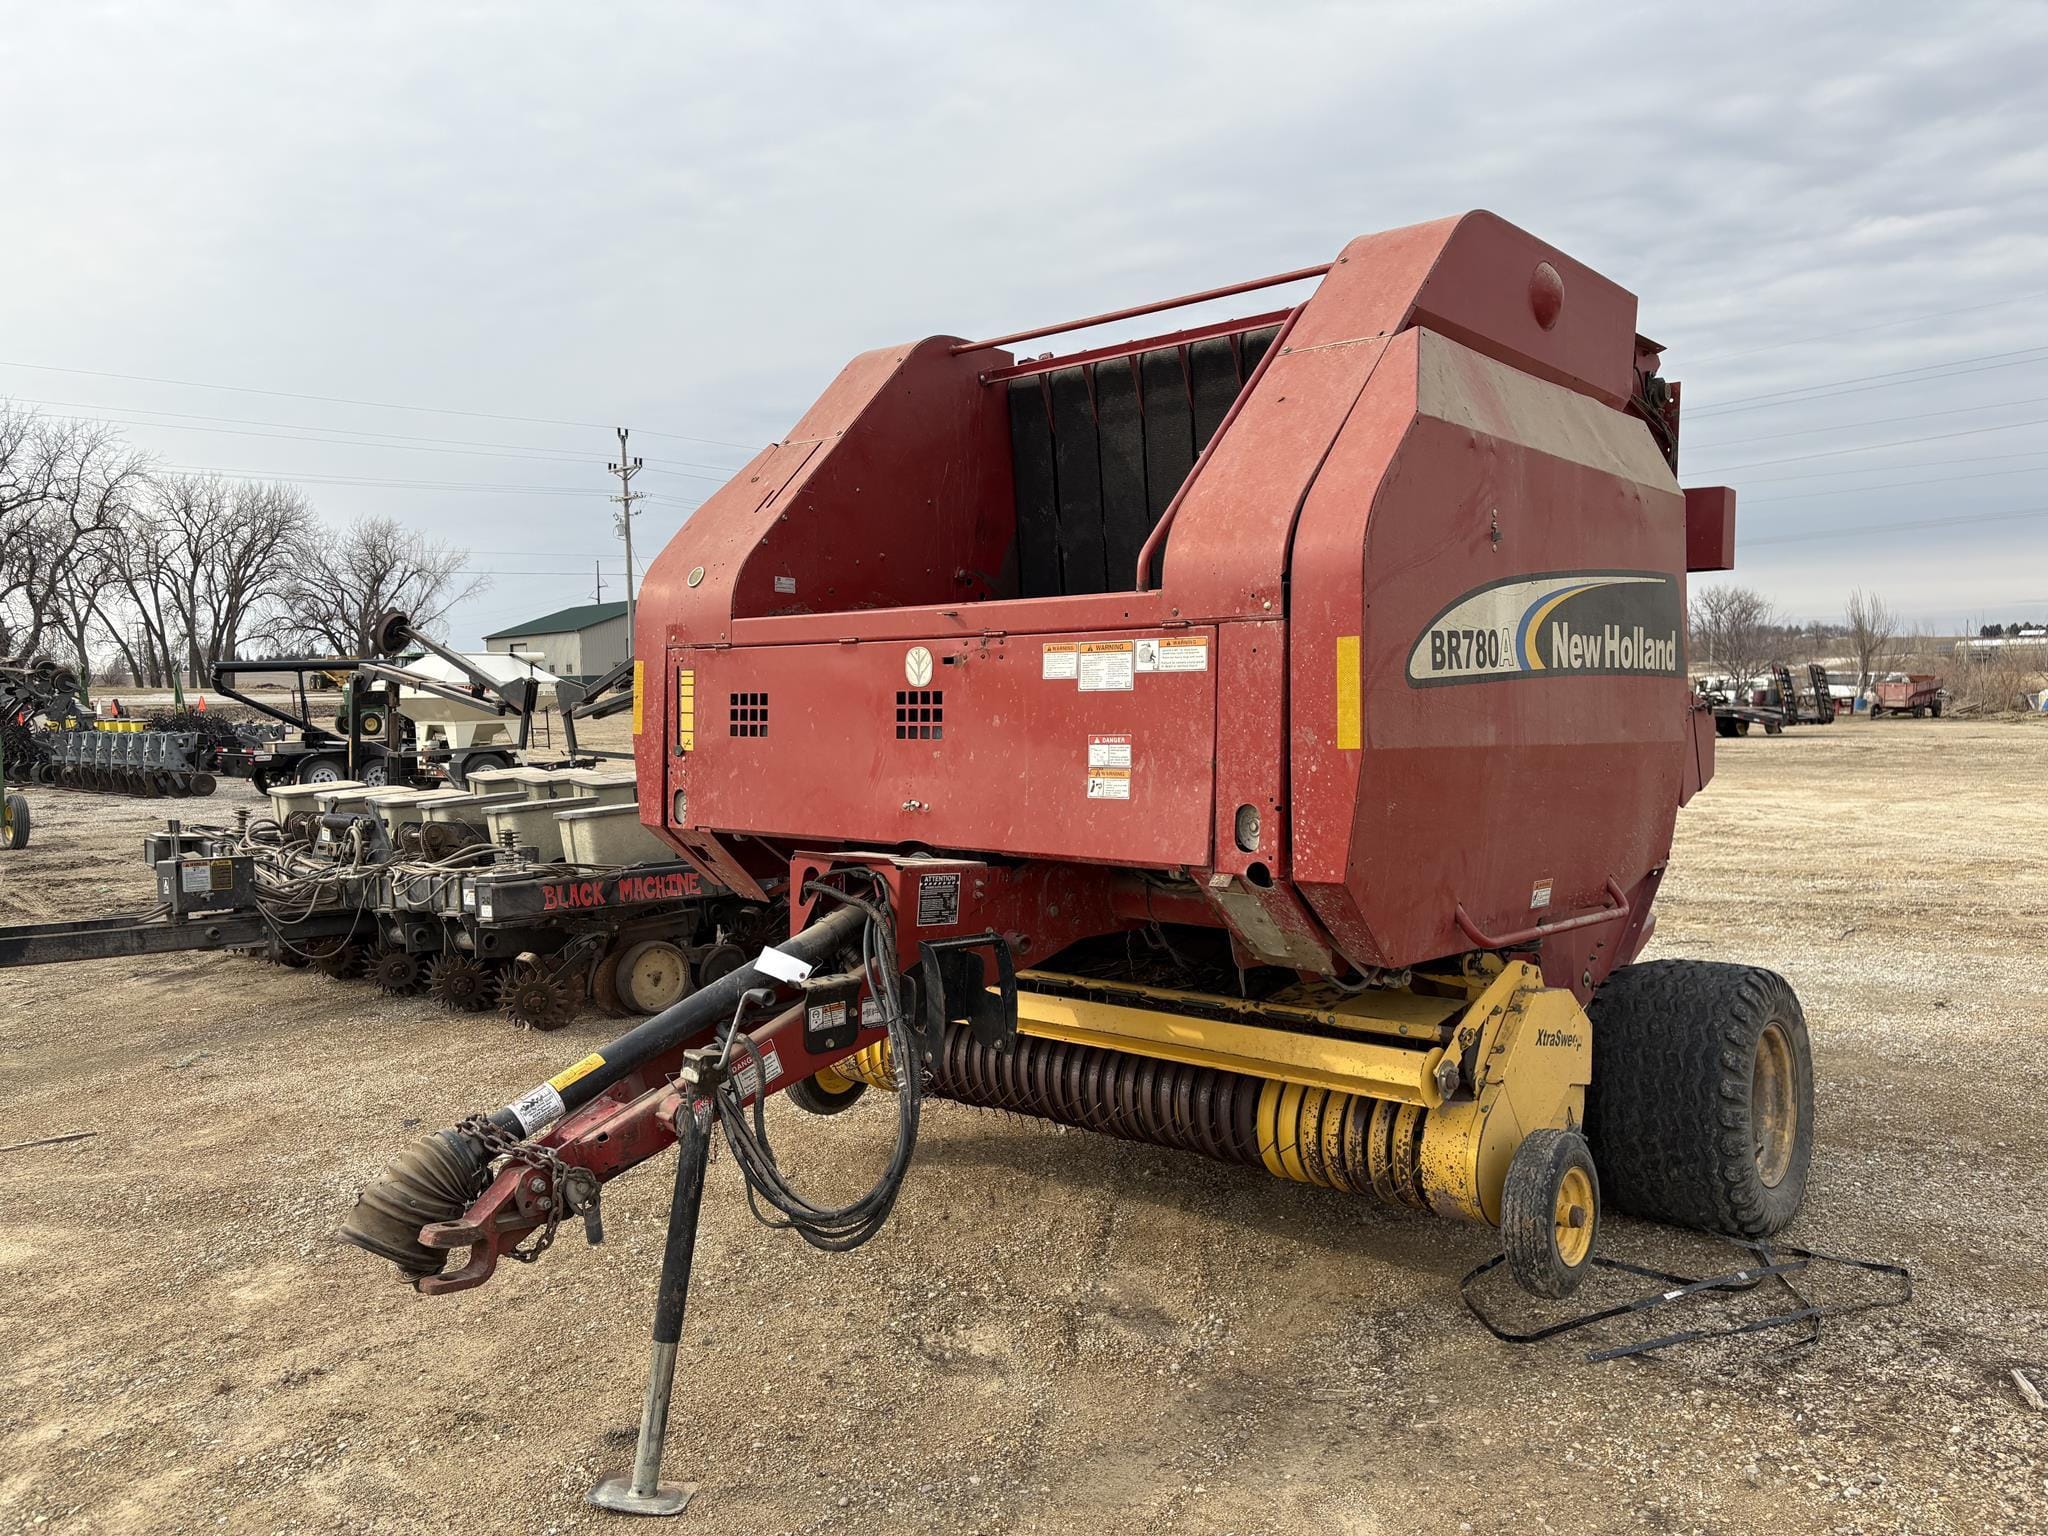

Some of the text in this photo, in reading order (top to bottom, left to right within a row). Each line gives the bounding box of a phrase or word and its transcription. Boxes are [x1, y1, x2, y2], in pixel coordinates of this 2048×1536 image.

[1095, 643, 1124, 651] WARNING
[1431, 627, 1514, 671] BR780A
[1552, 621, 1676, 671] New Holland
[1102, 736, 1126, 744] DANGER
[543, 873, 702, 910] BLACK MACHINE
[731, 1056, 753, 1074] DANG
